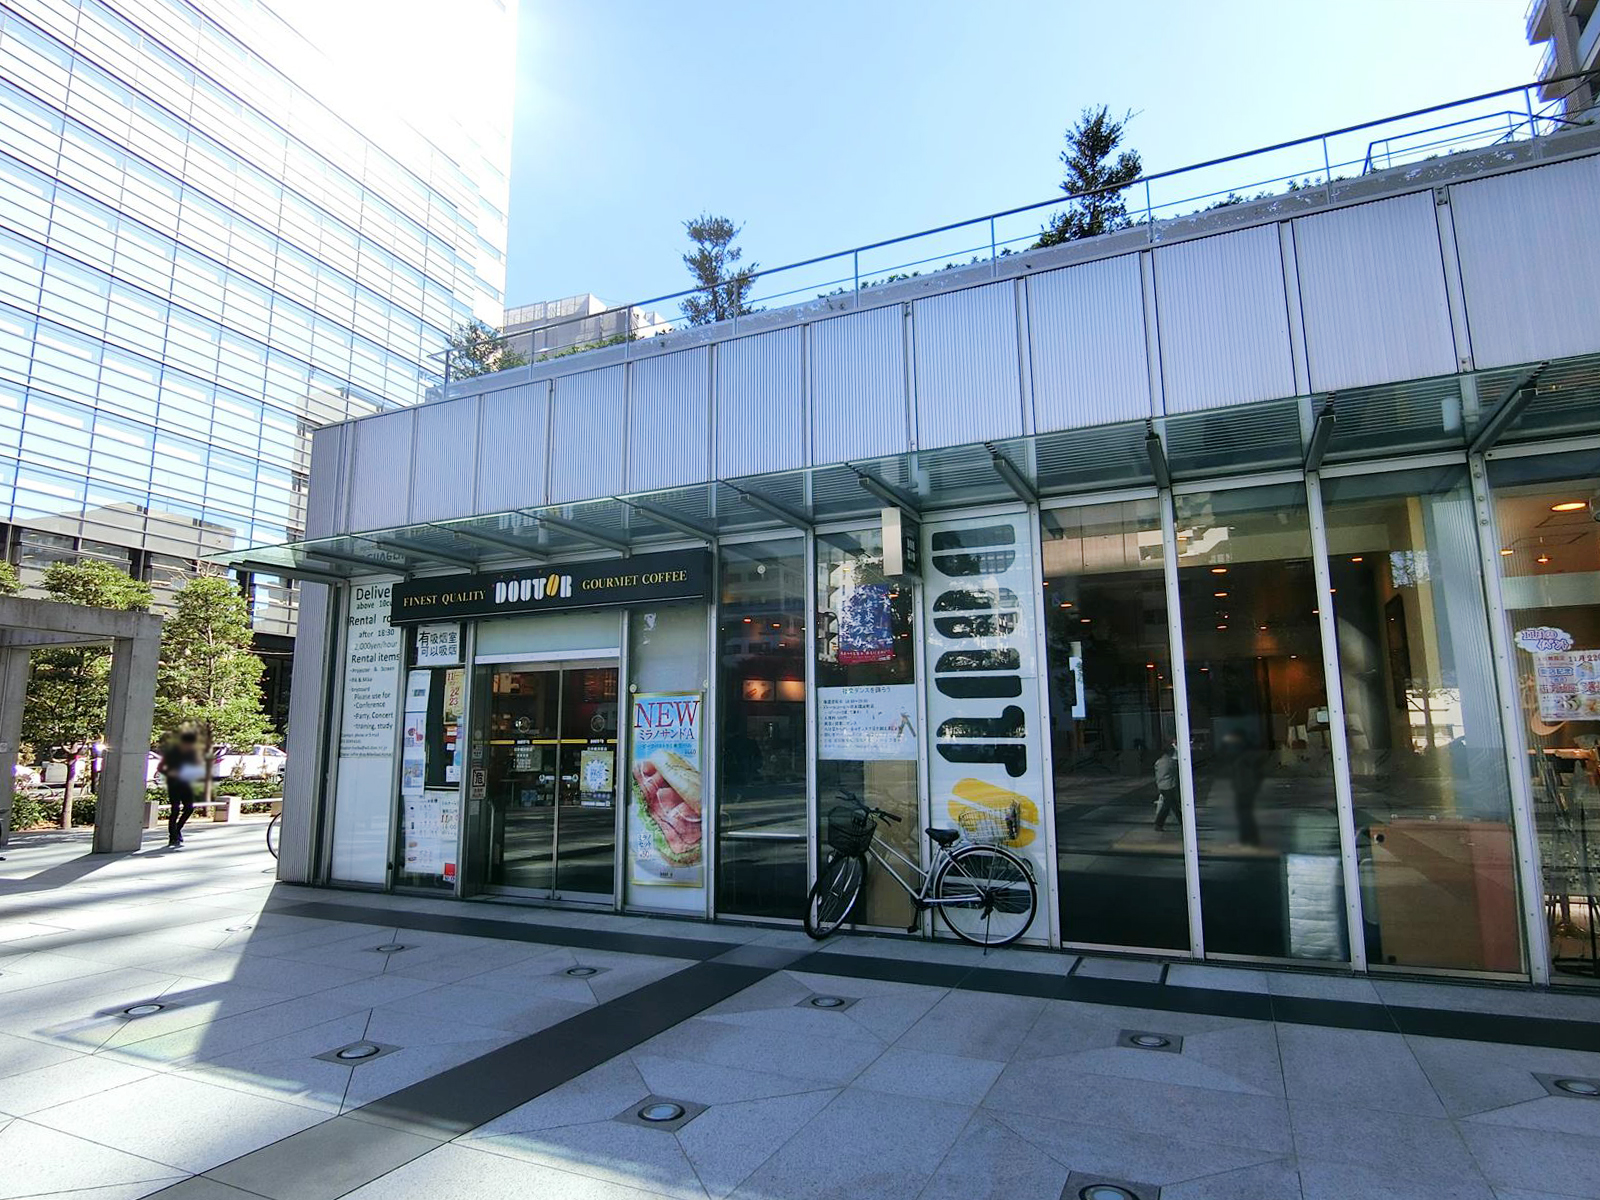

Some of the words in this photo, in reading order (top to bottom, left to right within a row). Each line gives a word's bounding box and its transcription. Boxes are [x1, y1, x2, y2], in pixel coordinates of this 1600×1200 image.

[403, 595, 438, 607] FINEST
[442, 590, 486, 605] QUALITY
[495, 573, 572, 604] DOUTOR
[582, 575, 639, 590] GOURMET
[641, 570, 687, 585] COFFEE
[356, 601, 375, 610] above
[349, 614, 377, 626] Rental
[358, 630, 374, 638] after
[378, 628, 395, 637] 18:30
[418, 631, 458, 645] 有吸烟室
[420, 644, 457, 657] 可以吸烟
[351, 653, 377, 664] Rental
[378, 653, 400, 662] items
[382, 691, 391, 699] for
[371, 711, 394, 719] Concert
[634, 700, 700, 728] NEW
[377, 722, 393, 730] study
